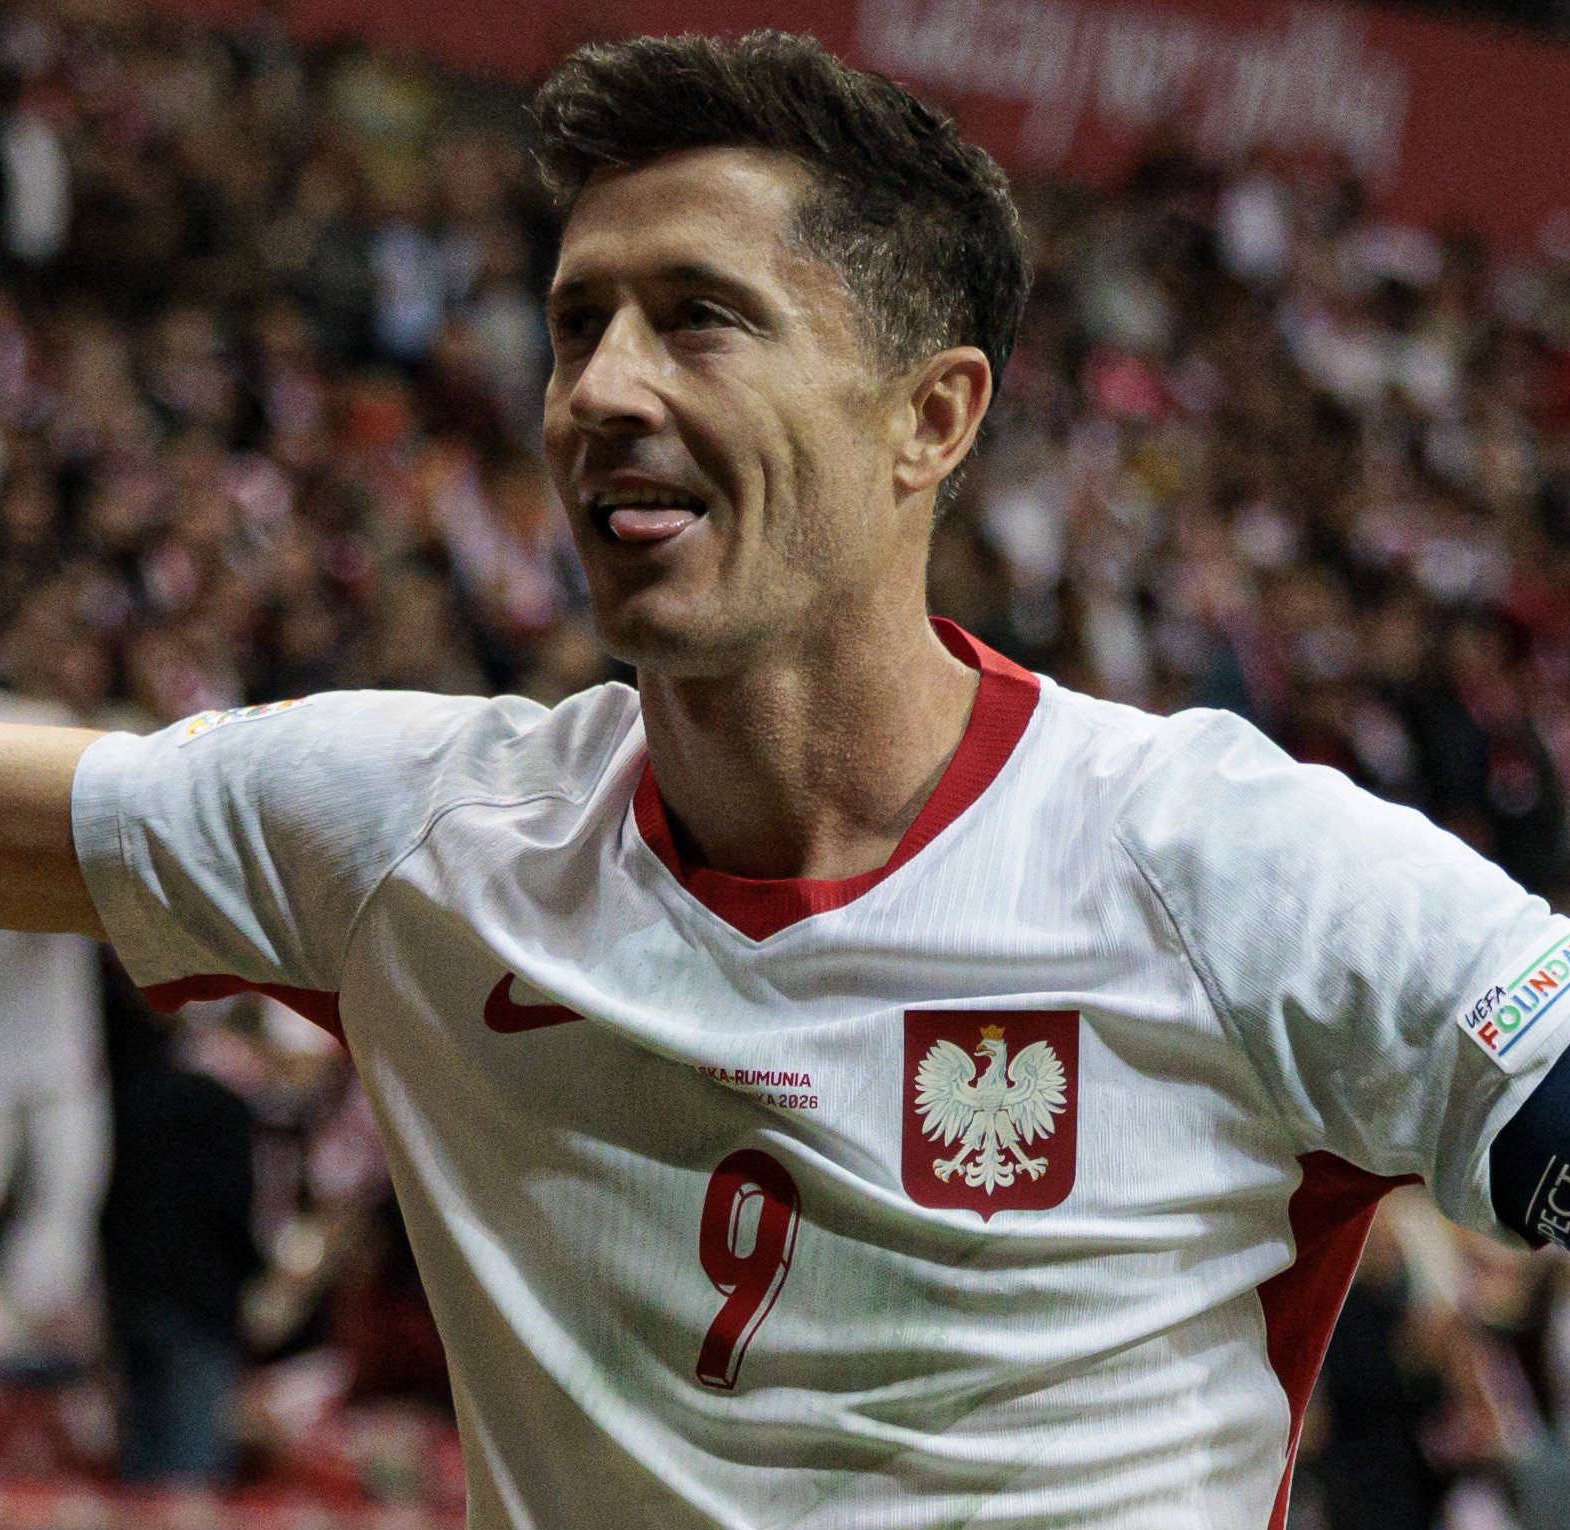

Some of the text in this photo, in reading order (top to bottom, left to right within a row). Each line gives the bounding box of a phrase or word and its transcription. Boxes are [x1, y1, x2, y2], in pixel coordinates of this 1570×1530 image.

[1465, 985, 1507, 1029] UEFA
[697, 1066, 812, 1088] SKA-RUMUNIA
[779, 1094, 818, 1109] 2026
[695, 1149, 801, 1390] 9
